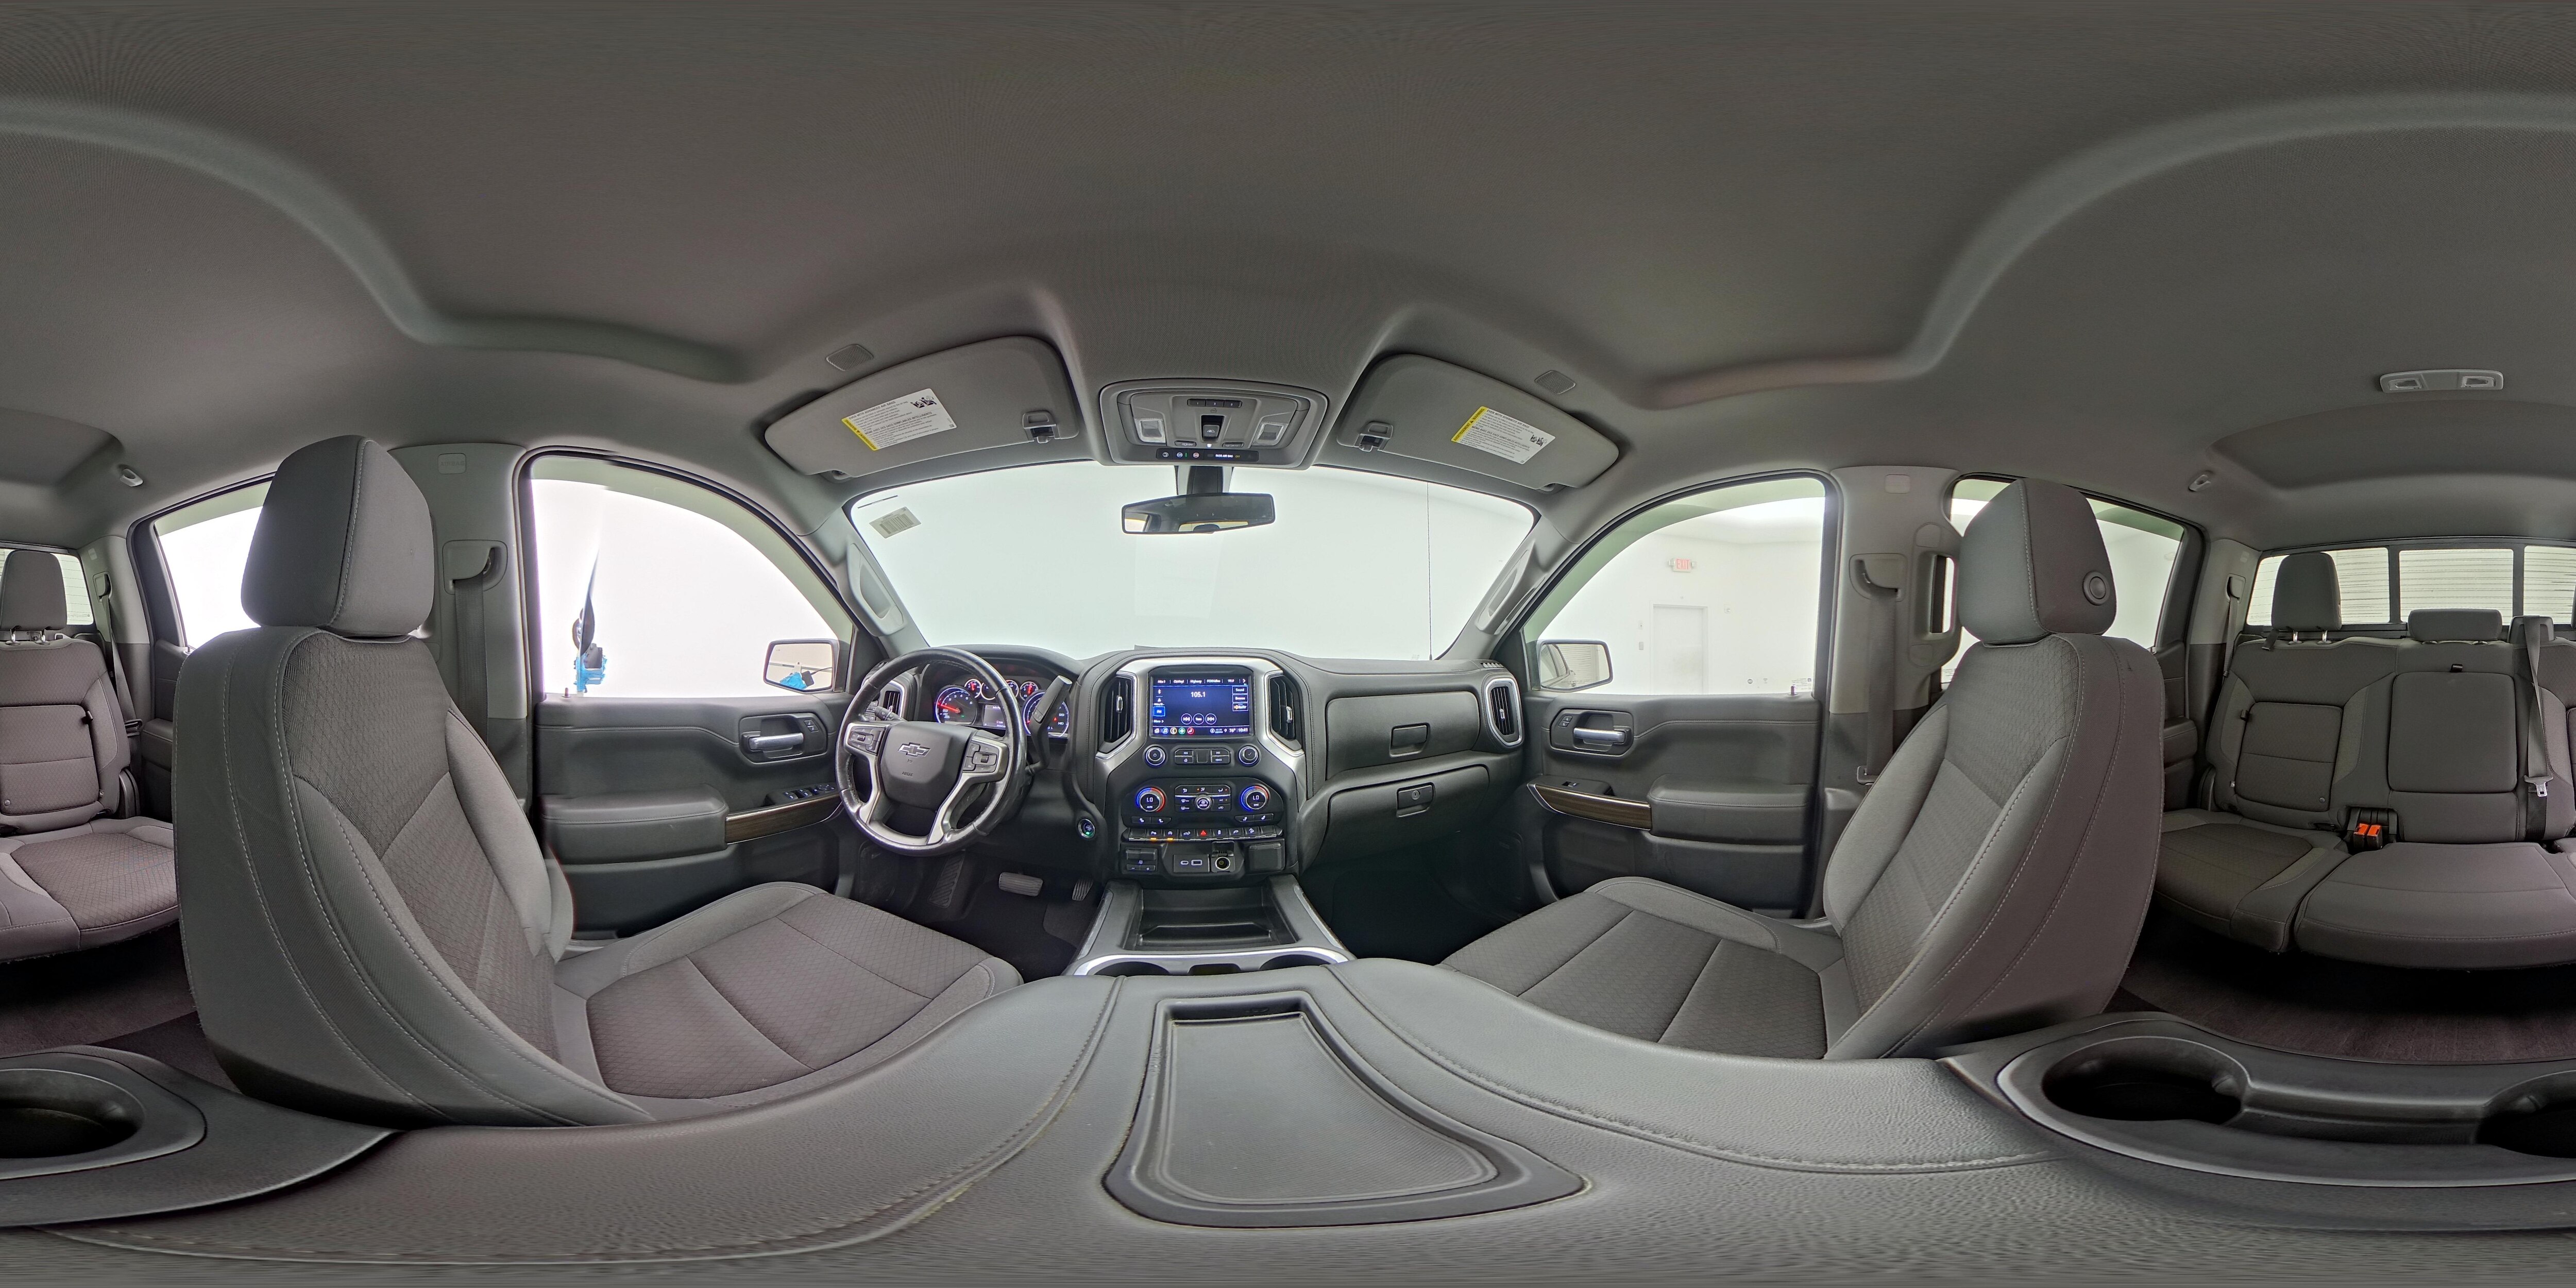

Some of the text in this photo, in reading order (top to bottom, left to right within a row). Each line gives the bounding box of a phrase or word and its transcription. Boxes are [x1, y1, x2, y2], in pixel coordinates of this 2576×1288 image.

[865, 405, 880, 414] ADVANCED
[1502, 415, 1517, 423] ADVANCED
[1676, 558, 1690, 569] EXIT
